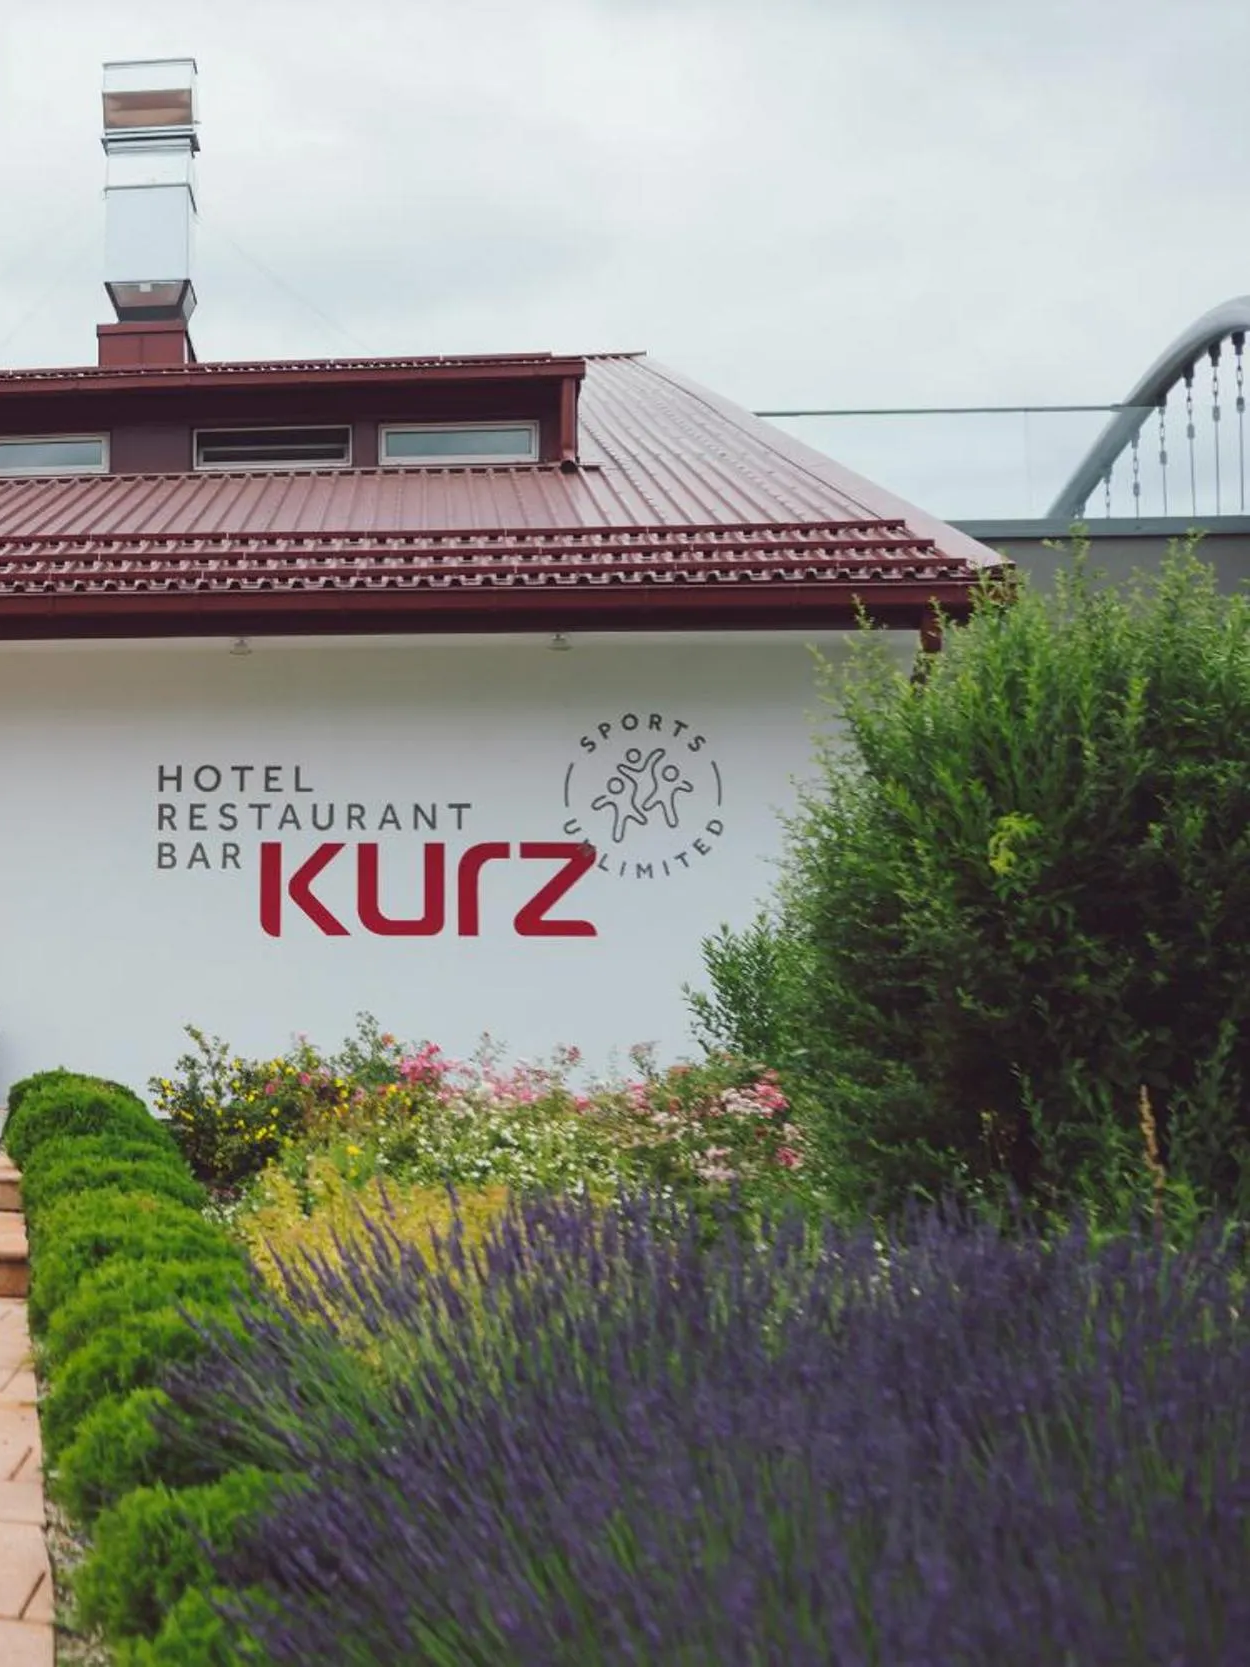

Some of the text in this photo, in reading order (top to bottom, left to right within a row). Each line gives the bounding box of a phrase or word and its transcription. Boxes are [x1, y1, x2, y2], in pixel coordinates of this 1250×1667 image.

[579, 713, 707, 753] SPORTS
[157, 765, 315, 792] HOTEL
[157, 803, 473, 831] RESTAURANT
[157, 842, 242, 869] BAR
